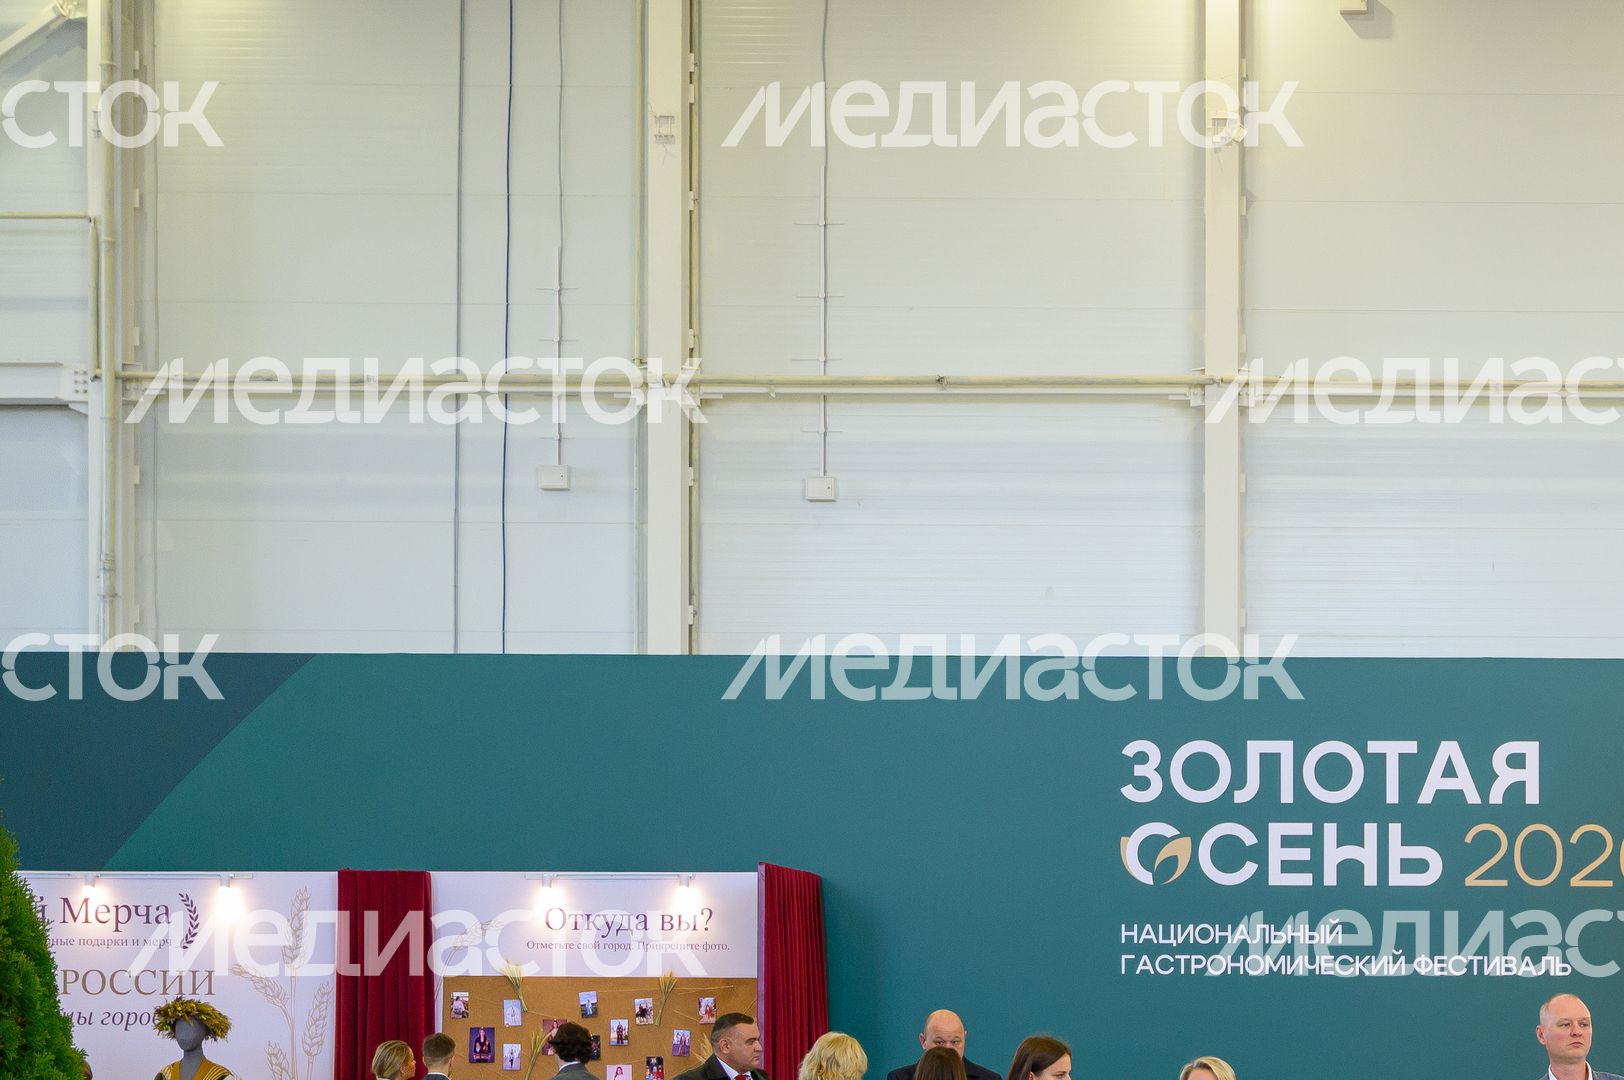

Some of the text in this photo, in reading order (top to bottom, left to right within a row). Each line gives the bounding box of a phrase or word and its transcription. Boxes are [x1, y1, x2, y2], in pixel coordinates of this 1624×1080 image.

[1119, 739, 1541, 805] ЗОЛОТАЯ
[1119, 821, 1444, 886] ОСЕНЬ
[59, 896, 172, 932] Мерча
[544, 907, 714, 938] Откуда вы?
[78, 938, 128, 949] подарки
[132, 938, 140, 947] и
[1120, 918, 1344, 944] НАЦИОНАЛЬНЫЙ
[526, 940, 575, 951] Отметьте
[576, 939, 600, 951] свой
[702, 939, 731, 953] фото.
[1120, 950, 1573, 977] ГАСТРОНОМИЧЕСКИЙ ФЕСТИВАЛЬ
[60, 967, 216, 996] РОССИИ
